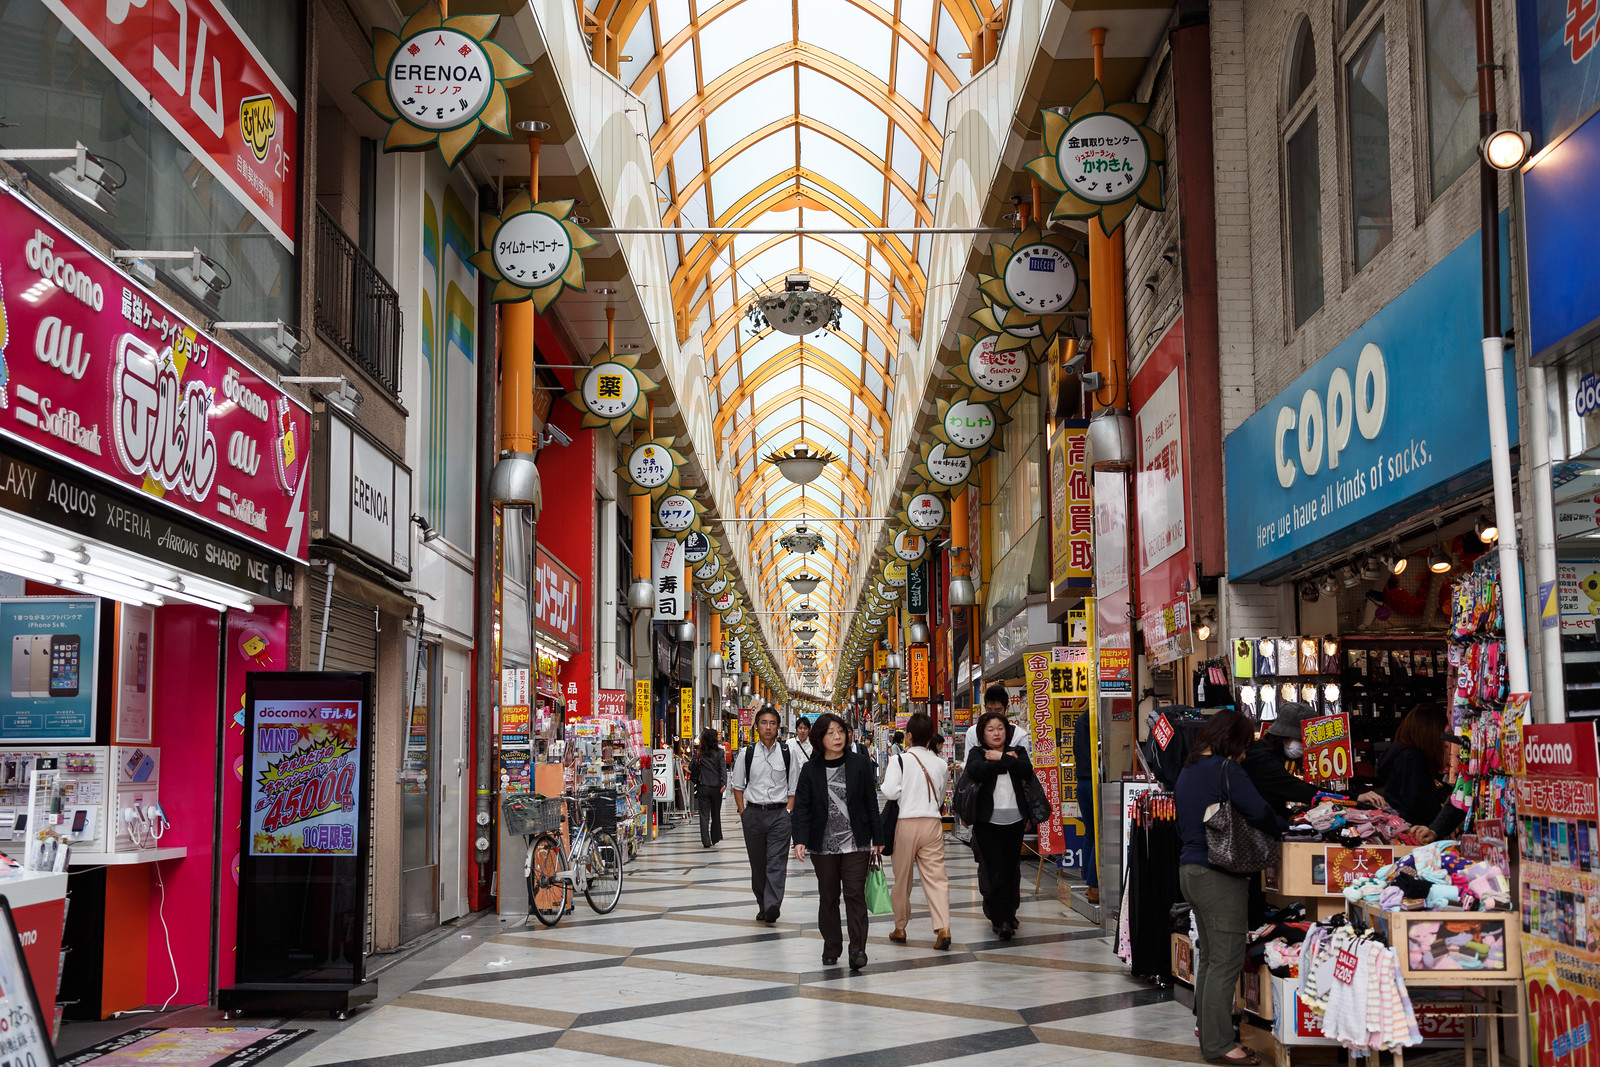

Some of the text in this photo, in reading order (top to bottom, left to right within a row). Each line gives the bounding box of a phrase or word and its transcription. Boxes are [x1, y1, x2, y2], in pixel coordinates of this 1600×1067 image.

[394, 64, 482, 82] ERENOA
[414, 85, 462, 95] エレノア
[402, 96, 469, 119] サンモール
[1068, 136, 1139, 149] 金買取りセンター
[274, 143, 290, 183] 2F
[1082, 157, 1134, 174] かわきん
[1074, 173, 1133, 193] サンモール
[499, 239, 564, 256] タイムカードコーナー
[1051, 251, 1070, 269] PHS
[26, 229, 104, 311] docomo
[121, 286, 209, 368] 最強ケータイショップ
[36, 316, 91, 380] au
[222, 367, 269, 422] docomo
[600, 376, 621, 397] 薬
[39, 397, 103, 456] SoftBank
[121, 341, 217, 502] テルル
[949, 415, 992, 428] わしや
[228, 430, 261, 476] au
[642, 457, 656, 466] 中央
[637, 466, 665, 475] コンタクト
[353, 474, 389, 527] ERENOA
[1256, 519, 1275, 550] Here
[1278, 512, 1291, 540] we
[1320, 485, 1334, 517] all
[1337, 469, 1366, 509] kinds
[1370, 455, 1384, 491] of
[1388, 438, 1433, 482] socks.
[230, 492, 268, 533] SoftBank
[660, 509, 692, 520] サワノ
[48, 478, 97, 518] AQUOS
[106, 503, 152, 540] XPERIA
[157, 526, 199, 560] ARROWS
[205, 543, 242, 572] SHARP
[247, 558, 270, 585] NEC
[283, 574, 293, 592] LG
[1171, 519, 1183, 542] KING
[659, 575, 678, 616] 寿司
[1100, 658, 1130, 668] 作動中!
[1027, 654, 1052, 739] 金・プラチナ
[259, 707, 308, 719] docomo
[320, 707, 357, 719] テルル
[502, 713, 529, 723] 作動中!
[258, 727, 300, 753] MNP
[1304, 717, 1345, 747] 大創業祭
[278, 744, 336, 776] テルルだけの
[1525, 736, 1573, 765] docomo
[263, 755, 348, 795] キャッシュバック!!
[303, 824, 355, 850] 10月限定
[1352, 854, 1368, 871] 大
